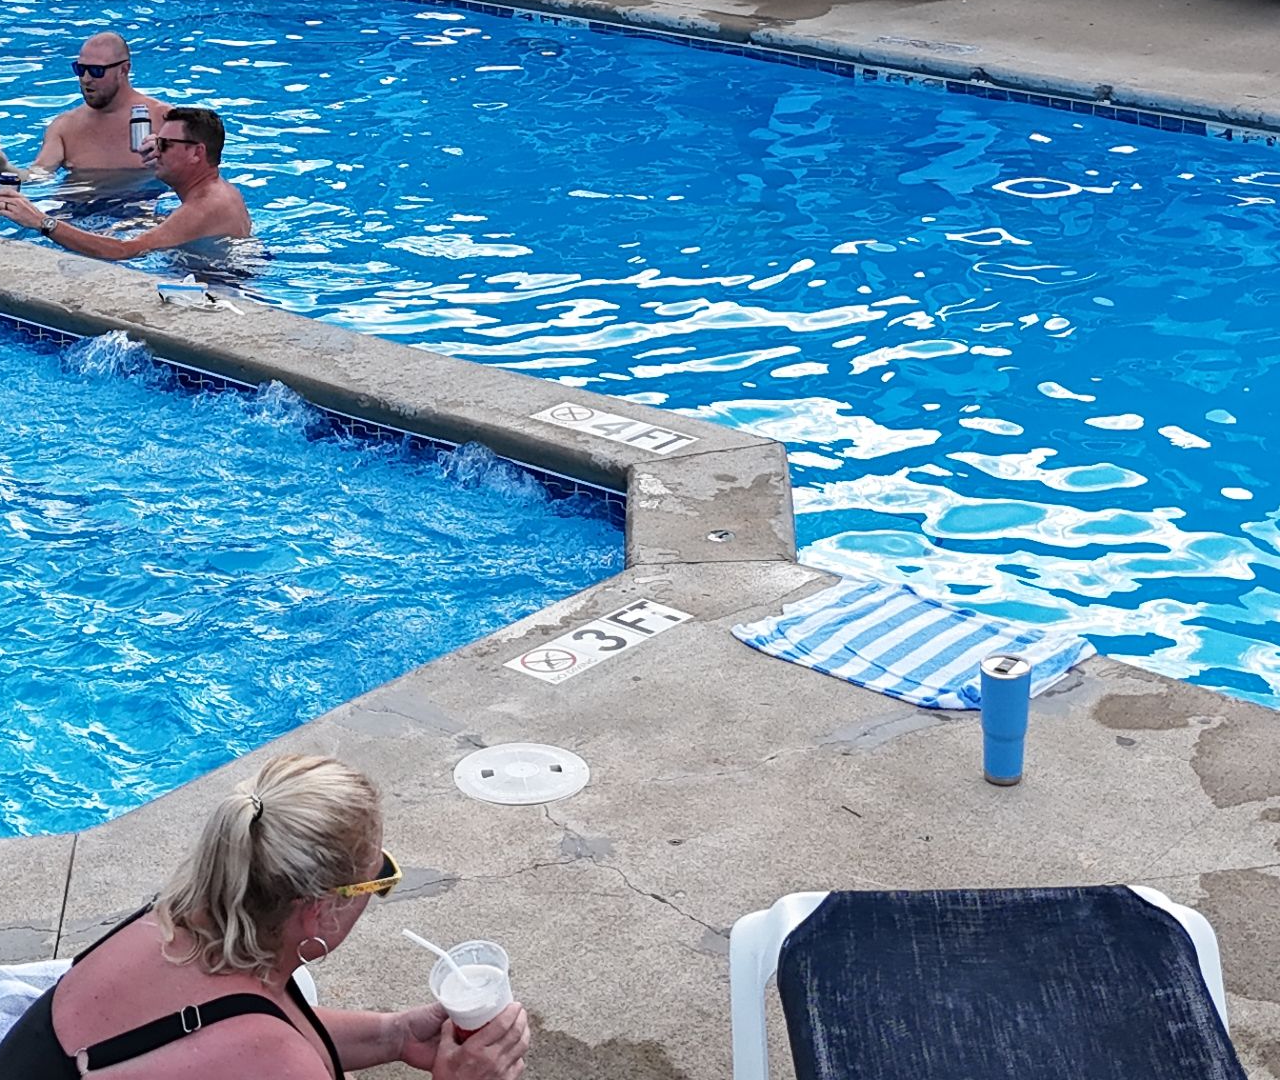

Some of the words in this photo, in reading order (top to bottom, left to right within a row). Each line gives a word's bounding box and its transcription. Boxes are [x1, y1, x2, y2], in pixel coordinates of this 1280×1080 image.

[590, 421, 640, 436] 4
[625, 427, 694, 451] FT
[572, 628, 628, 652] 3
[606, 600, 682, 635] FT
